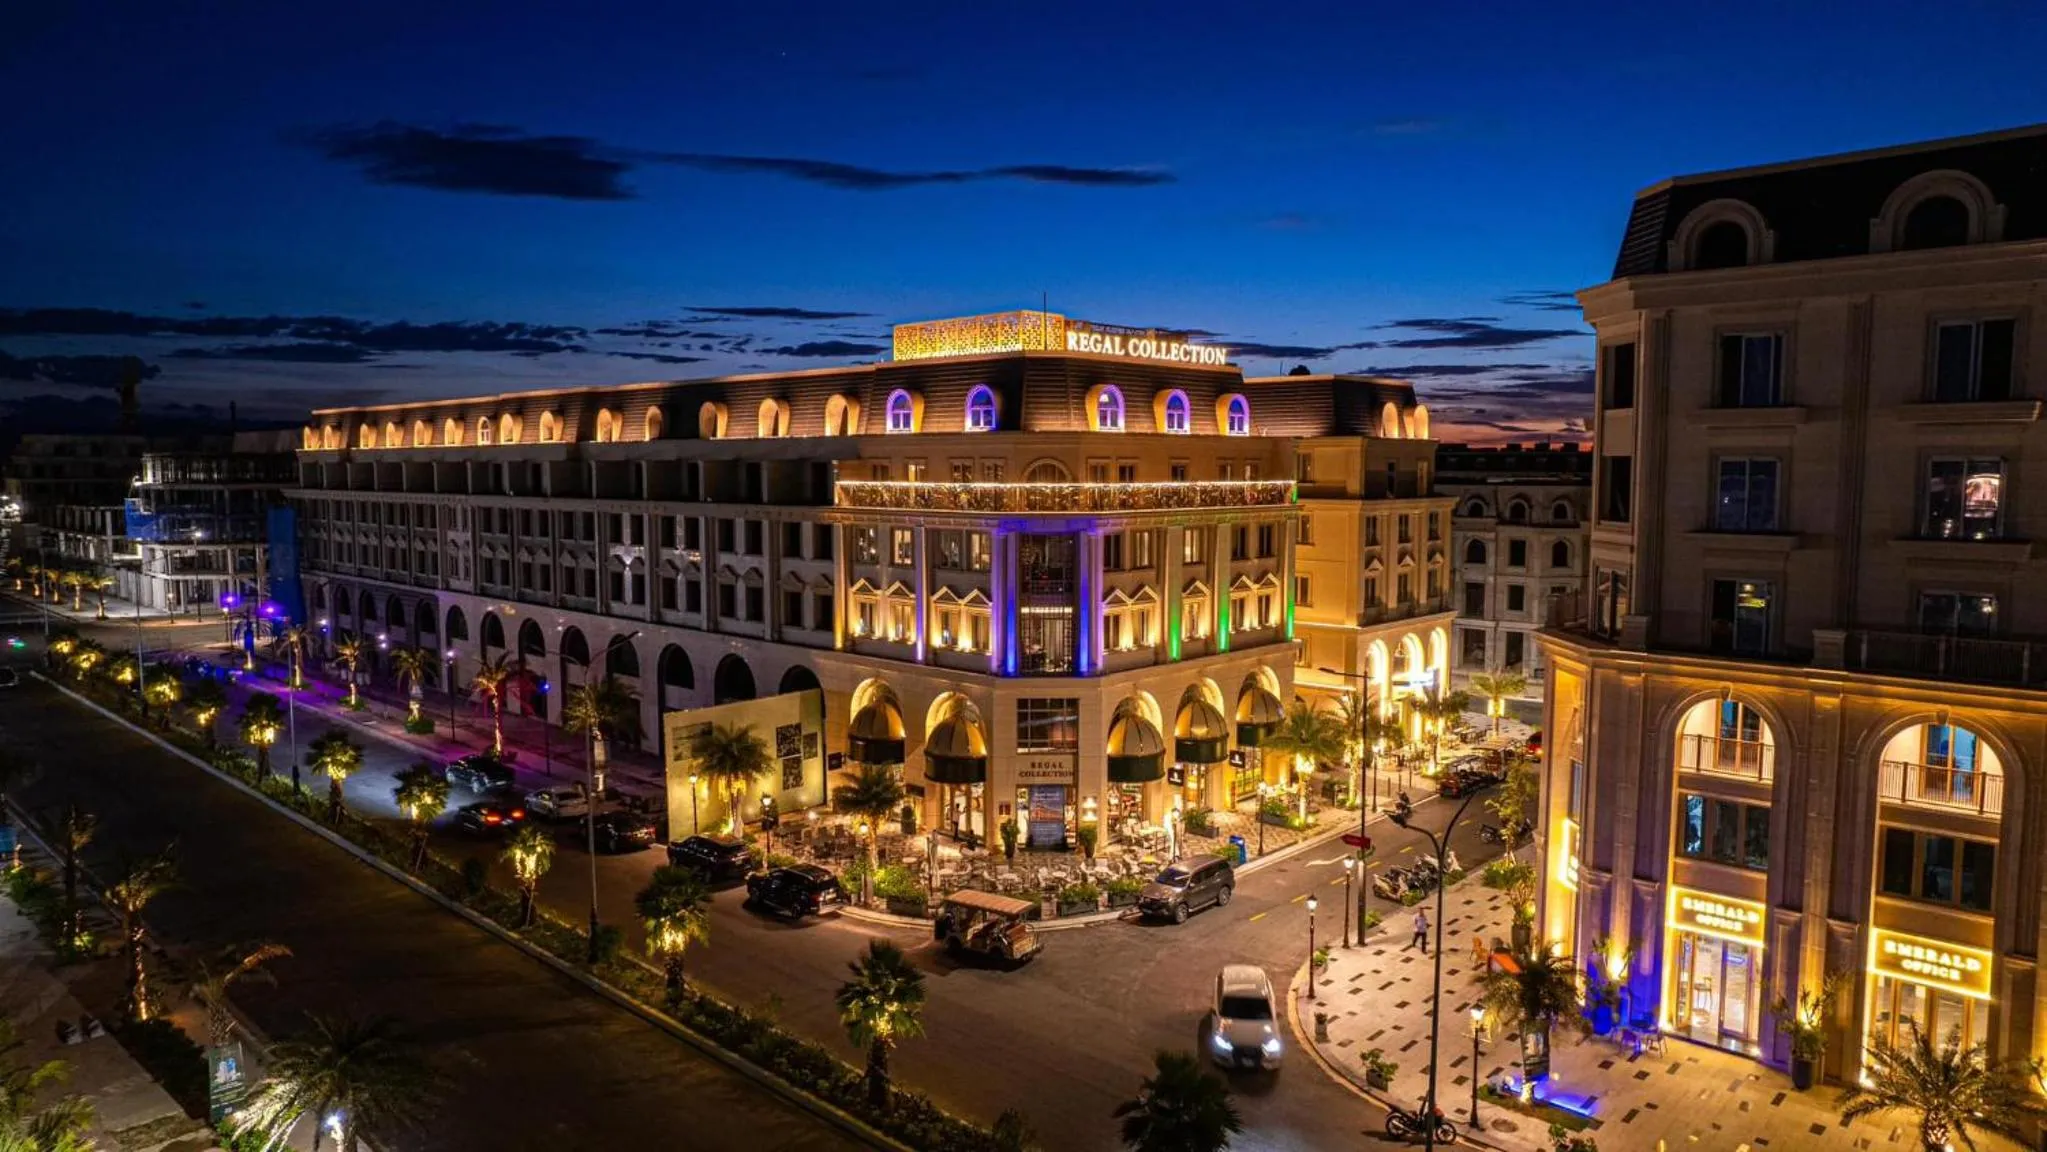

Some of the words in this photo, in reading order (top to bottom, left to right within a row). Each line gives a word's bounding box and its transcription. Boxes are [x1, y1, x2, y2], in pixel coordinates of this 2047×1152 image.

[1066, 331, 1124, 355] REGAL
[1128, 338, 1227, 365] COLLECTION
[1682, 896, 1760, 924] EMERALD
[1696, 913, 1743, 932] OFFICE
[1884, 939, 1982, 971] EMERALD
[1901, 958, 1961, 981] OFFICE
